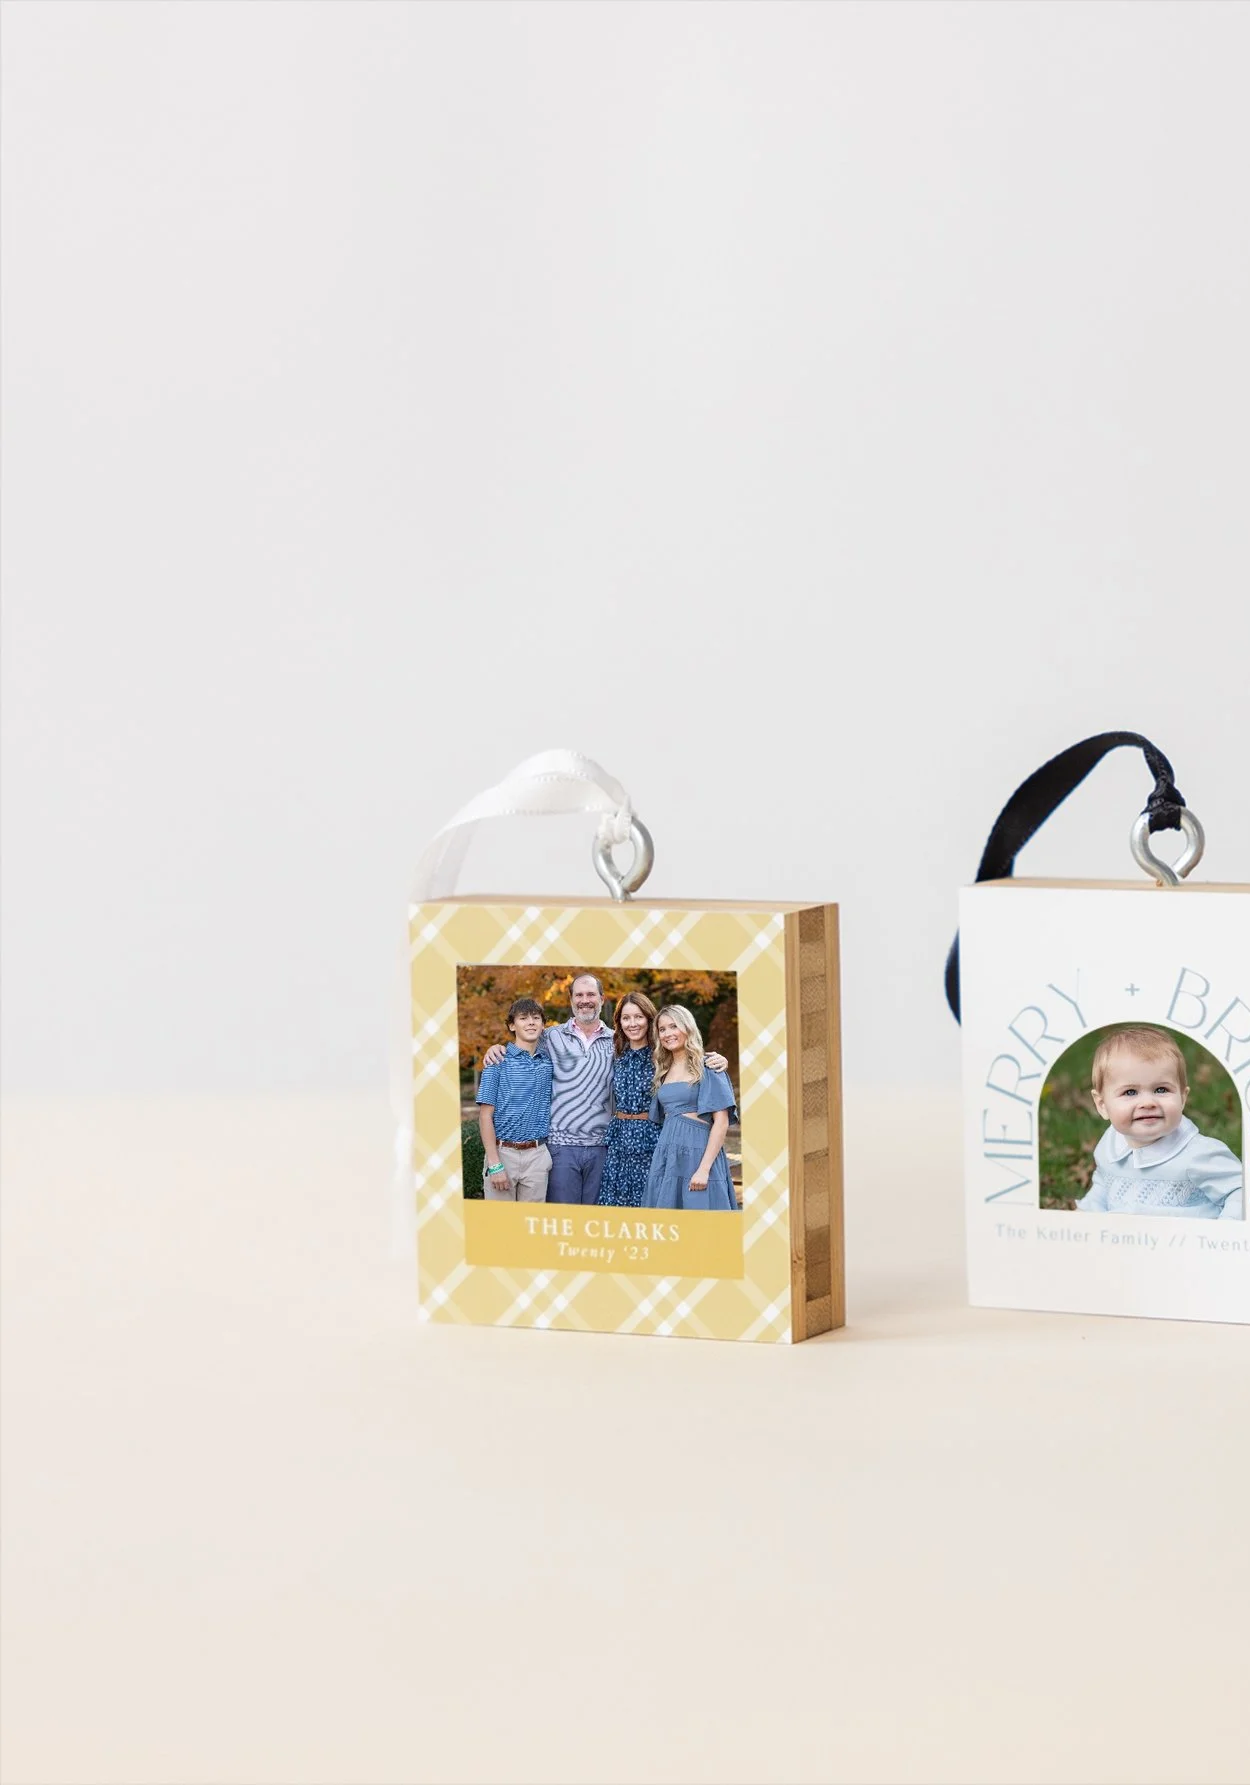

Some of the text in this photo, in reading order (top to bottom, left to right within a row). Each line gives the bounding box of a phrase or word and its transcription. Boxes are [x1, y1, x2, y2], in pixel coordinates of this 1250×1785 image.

[983, 968, 1088, 1206] MERRY
[525, 1216, 680, 1242] THE CLARKS
[995, 1224, 1027, 1240] The
[1036, 1226, 1091, 1243] Keller
[1100, 1230, 1159, 1250] Family
[558, 1242, 616, 1263] Twenty
